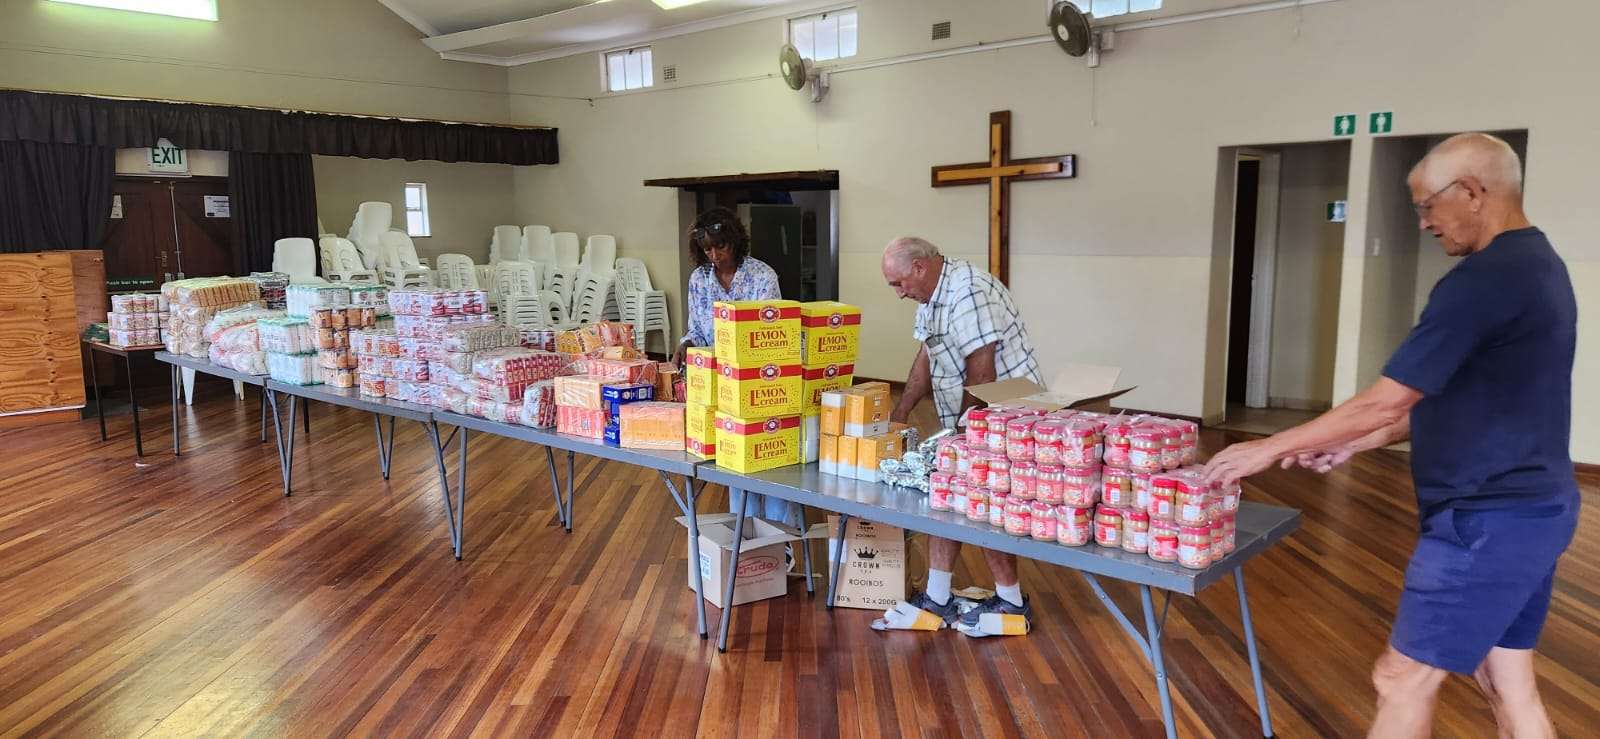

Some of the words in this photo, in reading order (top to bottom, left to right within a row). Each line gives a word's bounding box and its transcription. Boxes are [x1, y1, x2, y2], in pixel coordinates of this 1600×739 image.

[151, 147, 184, 164] EXIT
[750, 330, 787, 348] LEMON
[760, 339, 789, 348] cream
[818, 335, 848, 352] LEMON
[825, 344, 848, 352] cream
[750, 387, 787, 406] LEMON
[760, 397, 788, 406] cream
[754, 439, 787, 459] LEMON
[762, 448, 788, 457] cream
[852, 561, 880, 569] CROWN
[848, 578, 884, 587] ROOIBOS
[862, 596, 871, 604] 12
[878, 598, 897, 606] 200G
